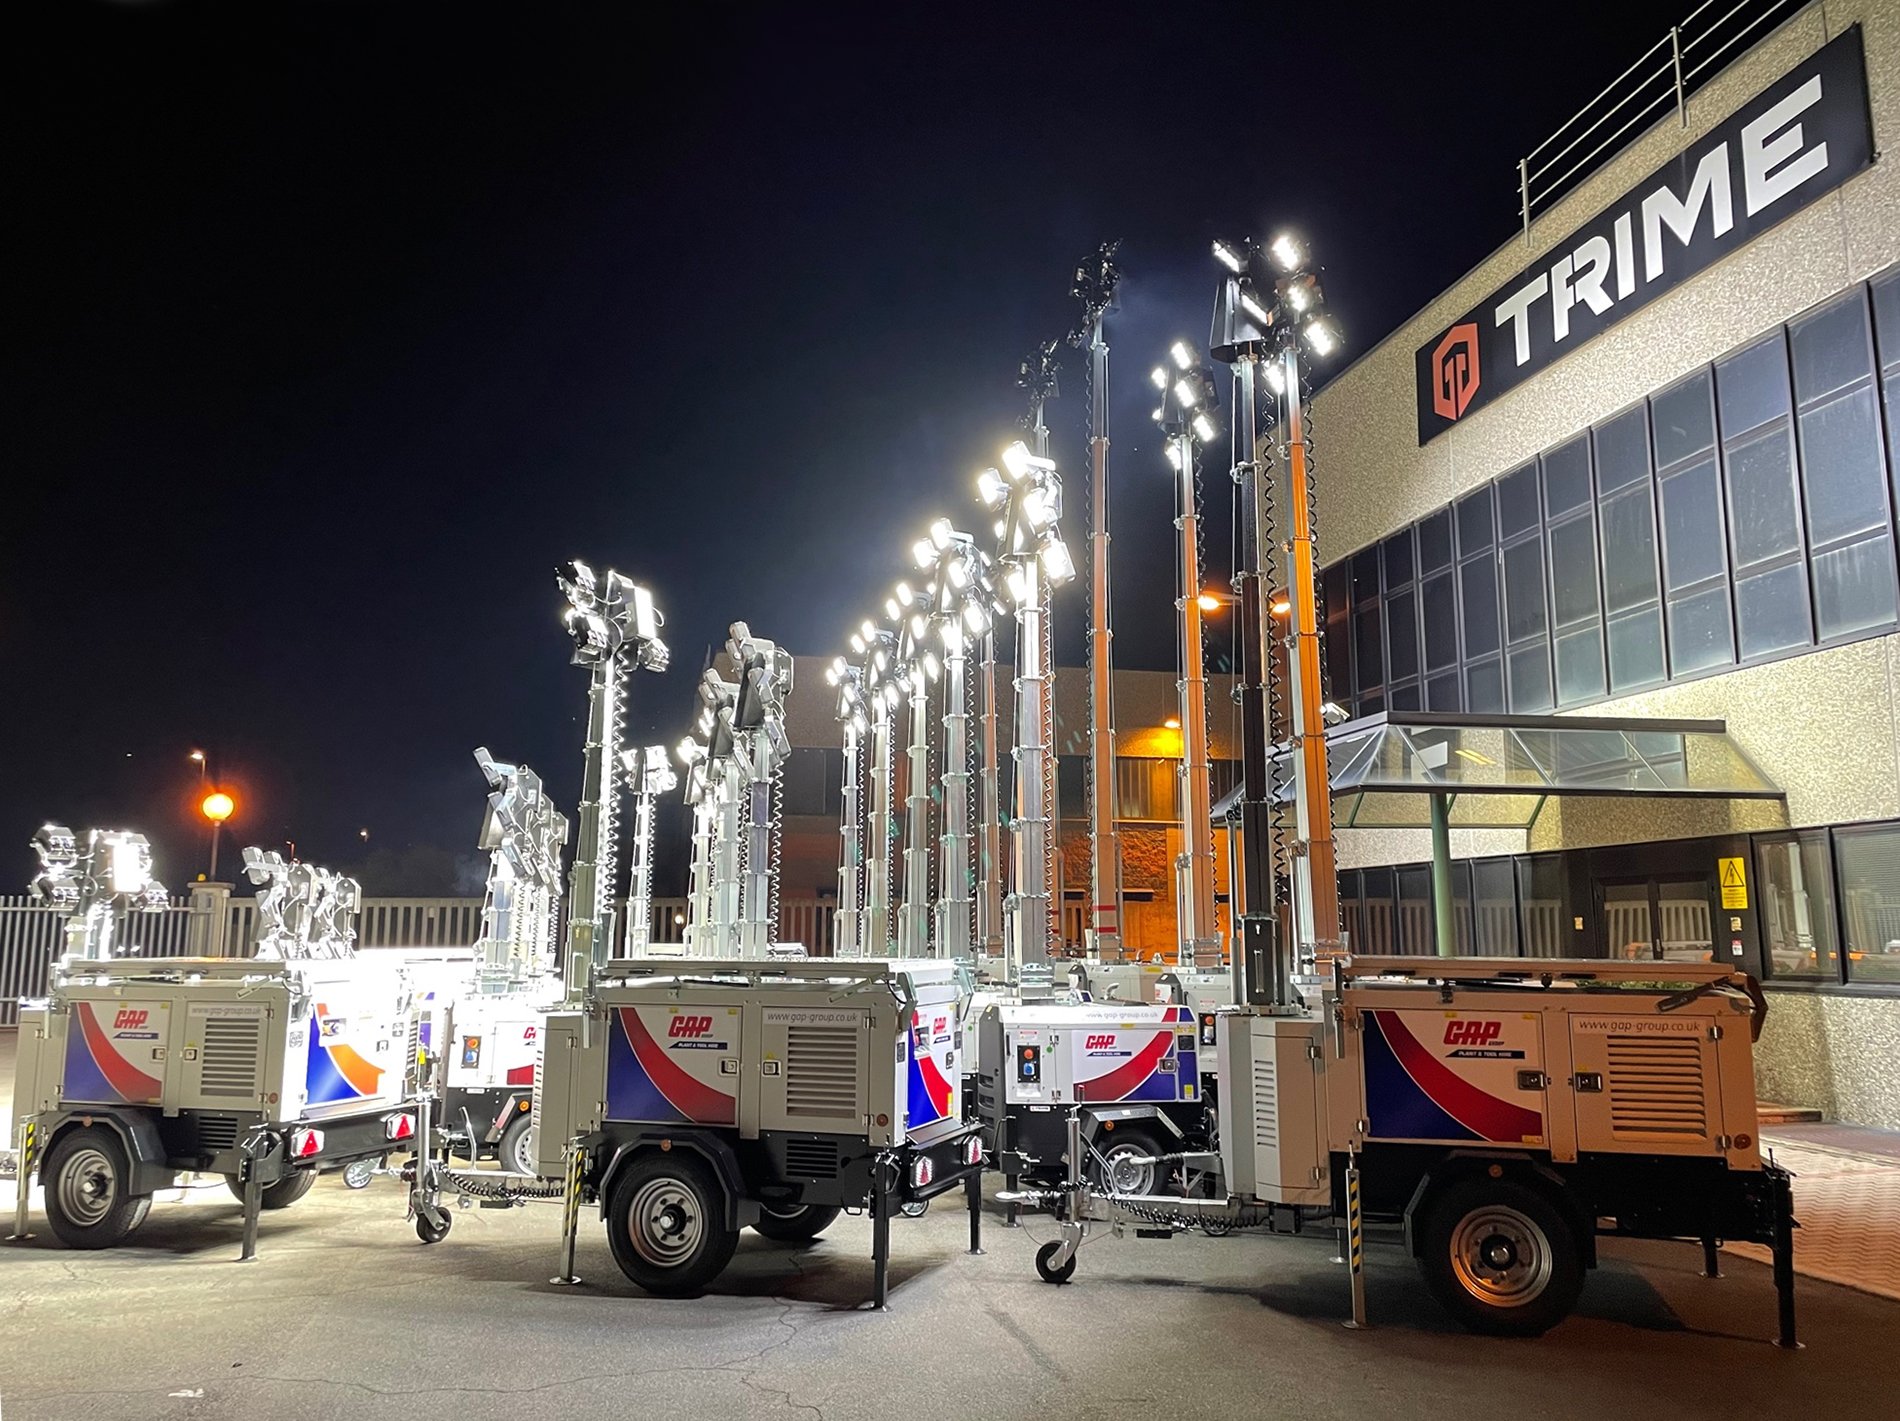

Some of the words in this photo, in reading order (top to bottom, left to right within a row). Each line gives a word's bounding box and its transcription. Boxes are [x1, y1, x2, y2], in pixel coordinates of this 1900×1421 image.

[1495, 74, 1829, 367] TRIME
[113, 1010, 149, 1029] GAP
[668, 1016, 713, 1038] GAP
[768, 1012, 857, 1023] www.gap-group.co.uk
[1580, 1021, 1700, 1032] www.gap-group.co.uk
[1085, 1035, 1116, 1049] GAP
[1443, 1021, 1502, 1046] GAP
